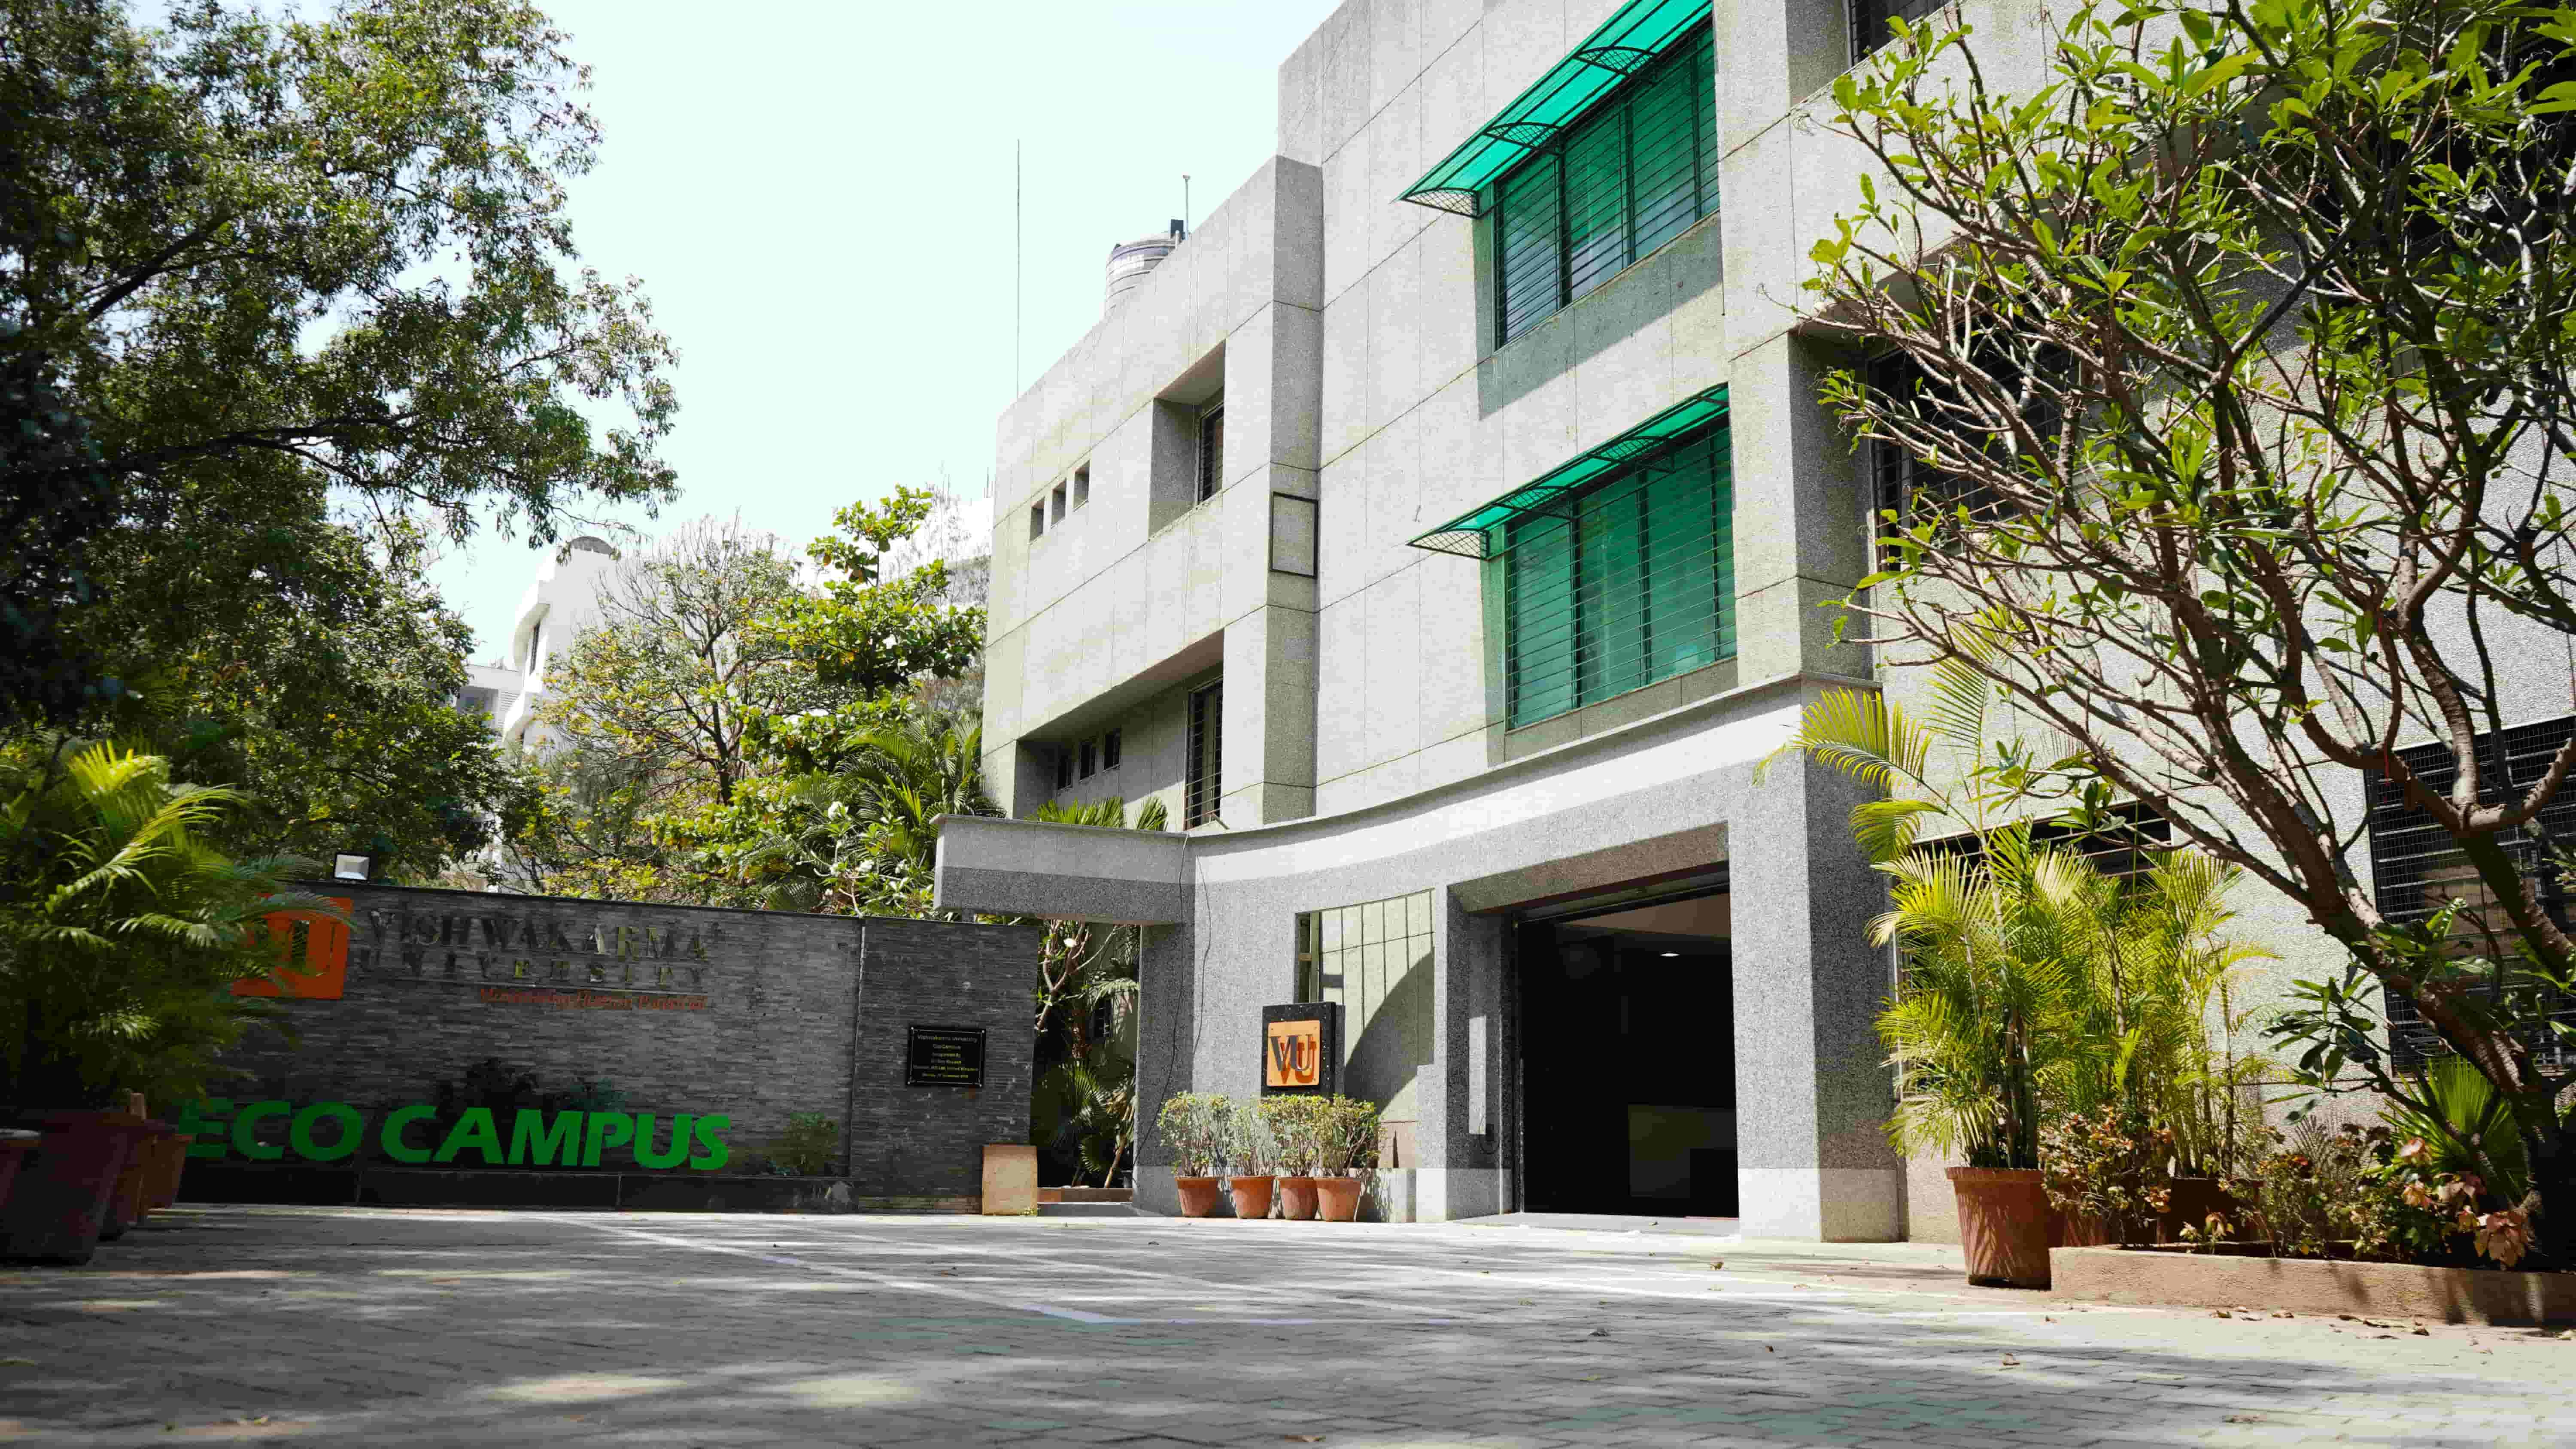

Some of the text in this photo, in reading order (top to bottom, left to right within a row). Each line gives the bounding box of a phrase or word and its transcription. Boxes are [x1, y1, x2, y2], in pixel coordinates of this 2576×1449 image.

[1268, 1034, 1314, 1072] VU
[178, 1097, 732, 1171] ECO CAMPUS
